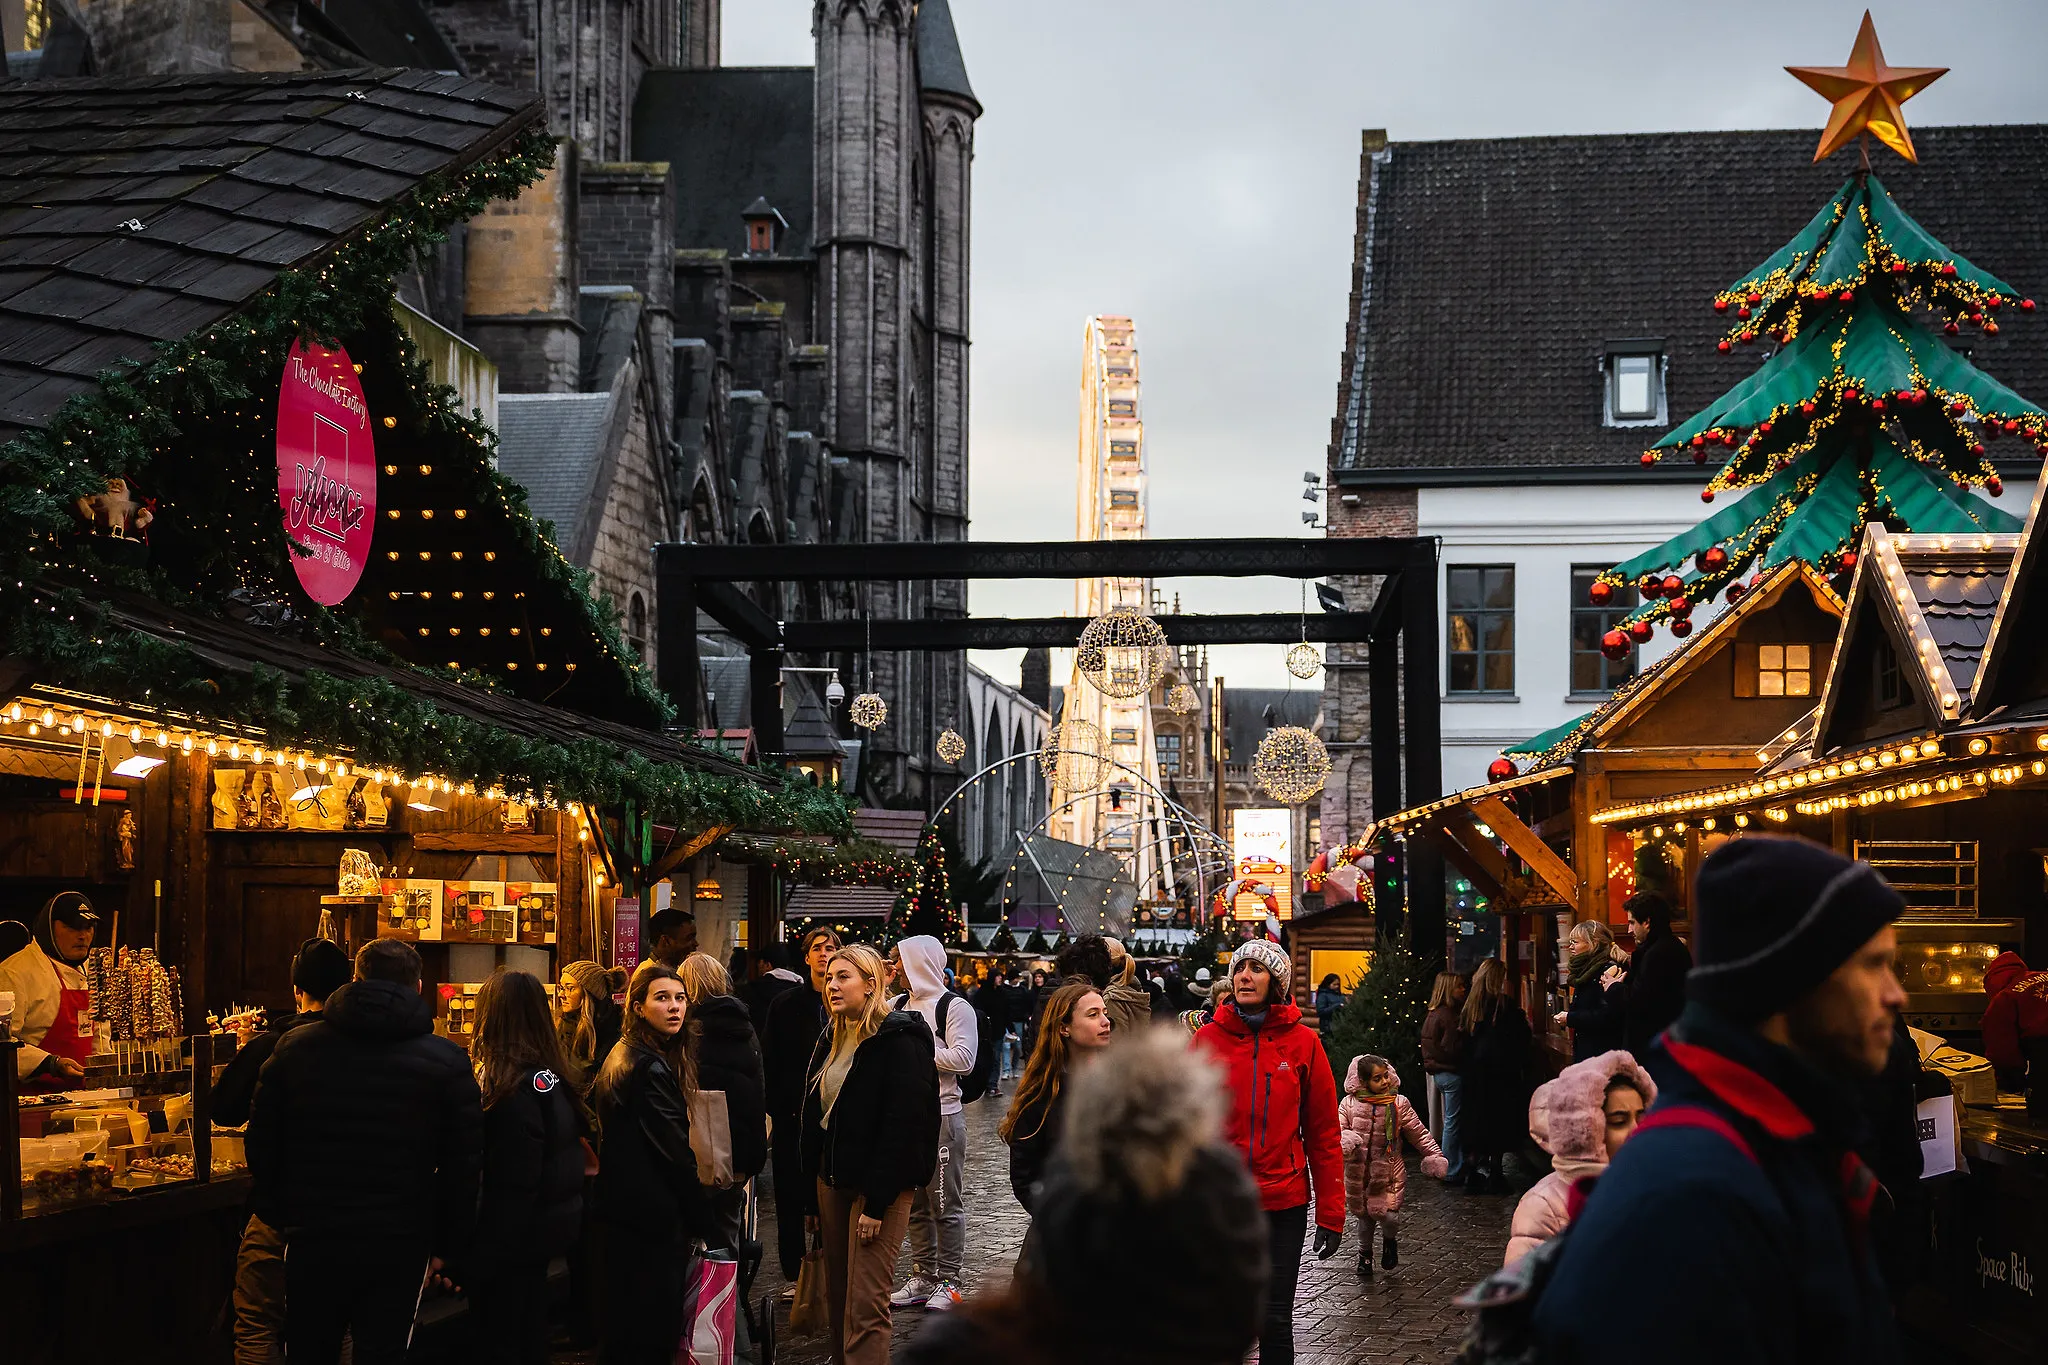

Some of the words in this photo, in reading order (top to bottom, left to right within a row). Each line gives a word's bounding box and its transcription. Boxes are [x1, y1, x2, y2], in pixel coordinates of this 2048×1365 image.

[292, 357, 308, 383] The
[309, 366, 342, 404] Chocolate
[340, 386, 366, 429] Factory
[1976, 1236, 2008, 1289] Space
